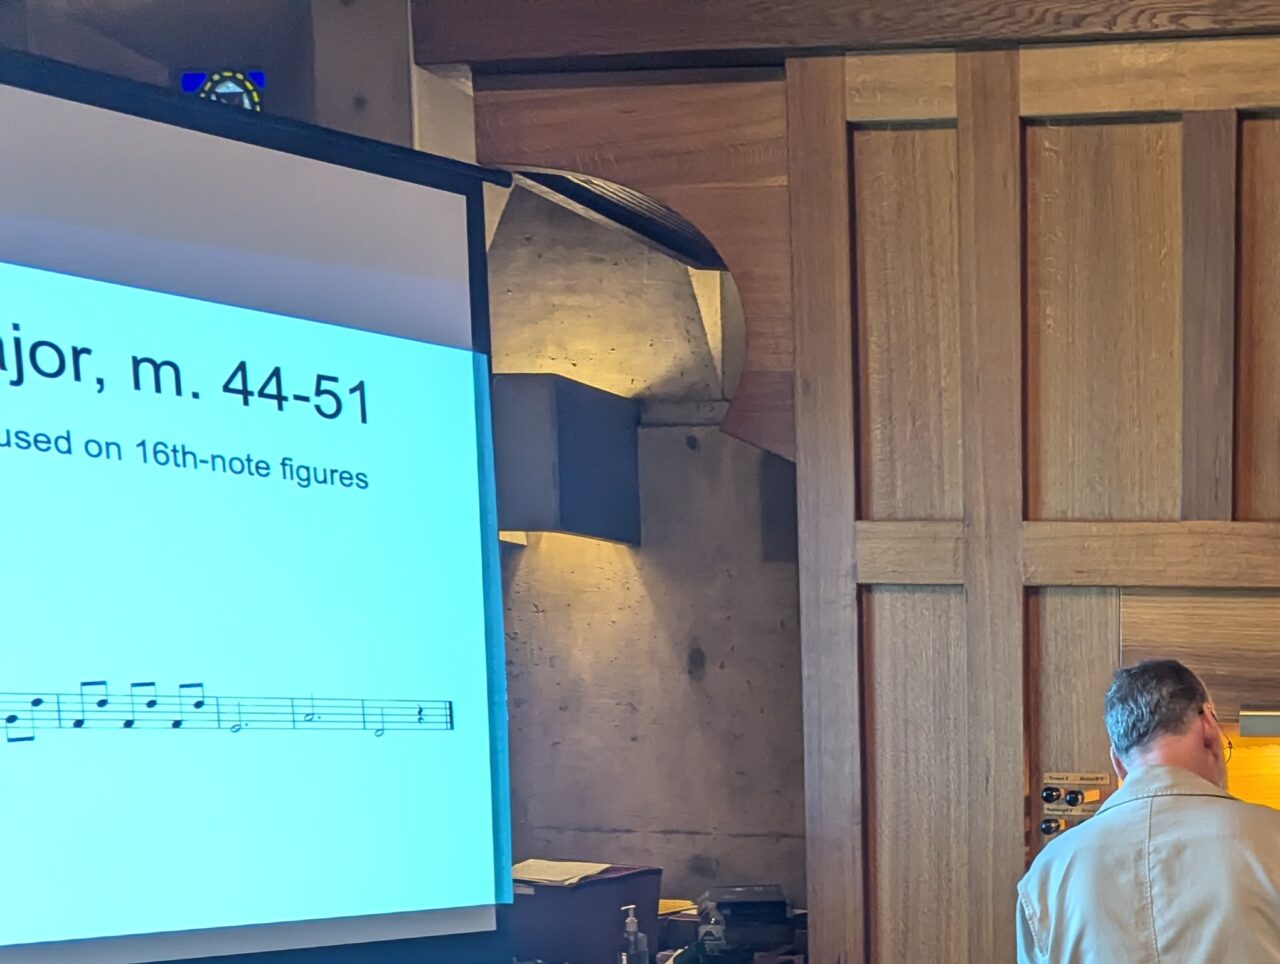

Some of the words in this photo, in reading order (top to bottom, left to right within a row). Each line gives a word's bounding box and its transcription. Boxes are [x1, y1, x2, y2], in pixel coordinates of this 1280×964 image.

[0, 322, 105, 394] jor,
[131, 355, 200, 400] m.
[222, 360, 368, 425] 44-51
[84, 439, 122, 461] on
[135, 439, 271, 480] 16th-note
[279, 456, 370, 490] figures
